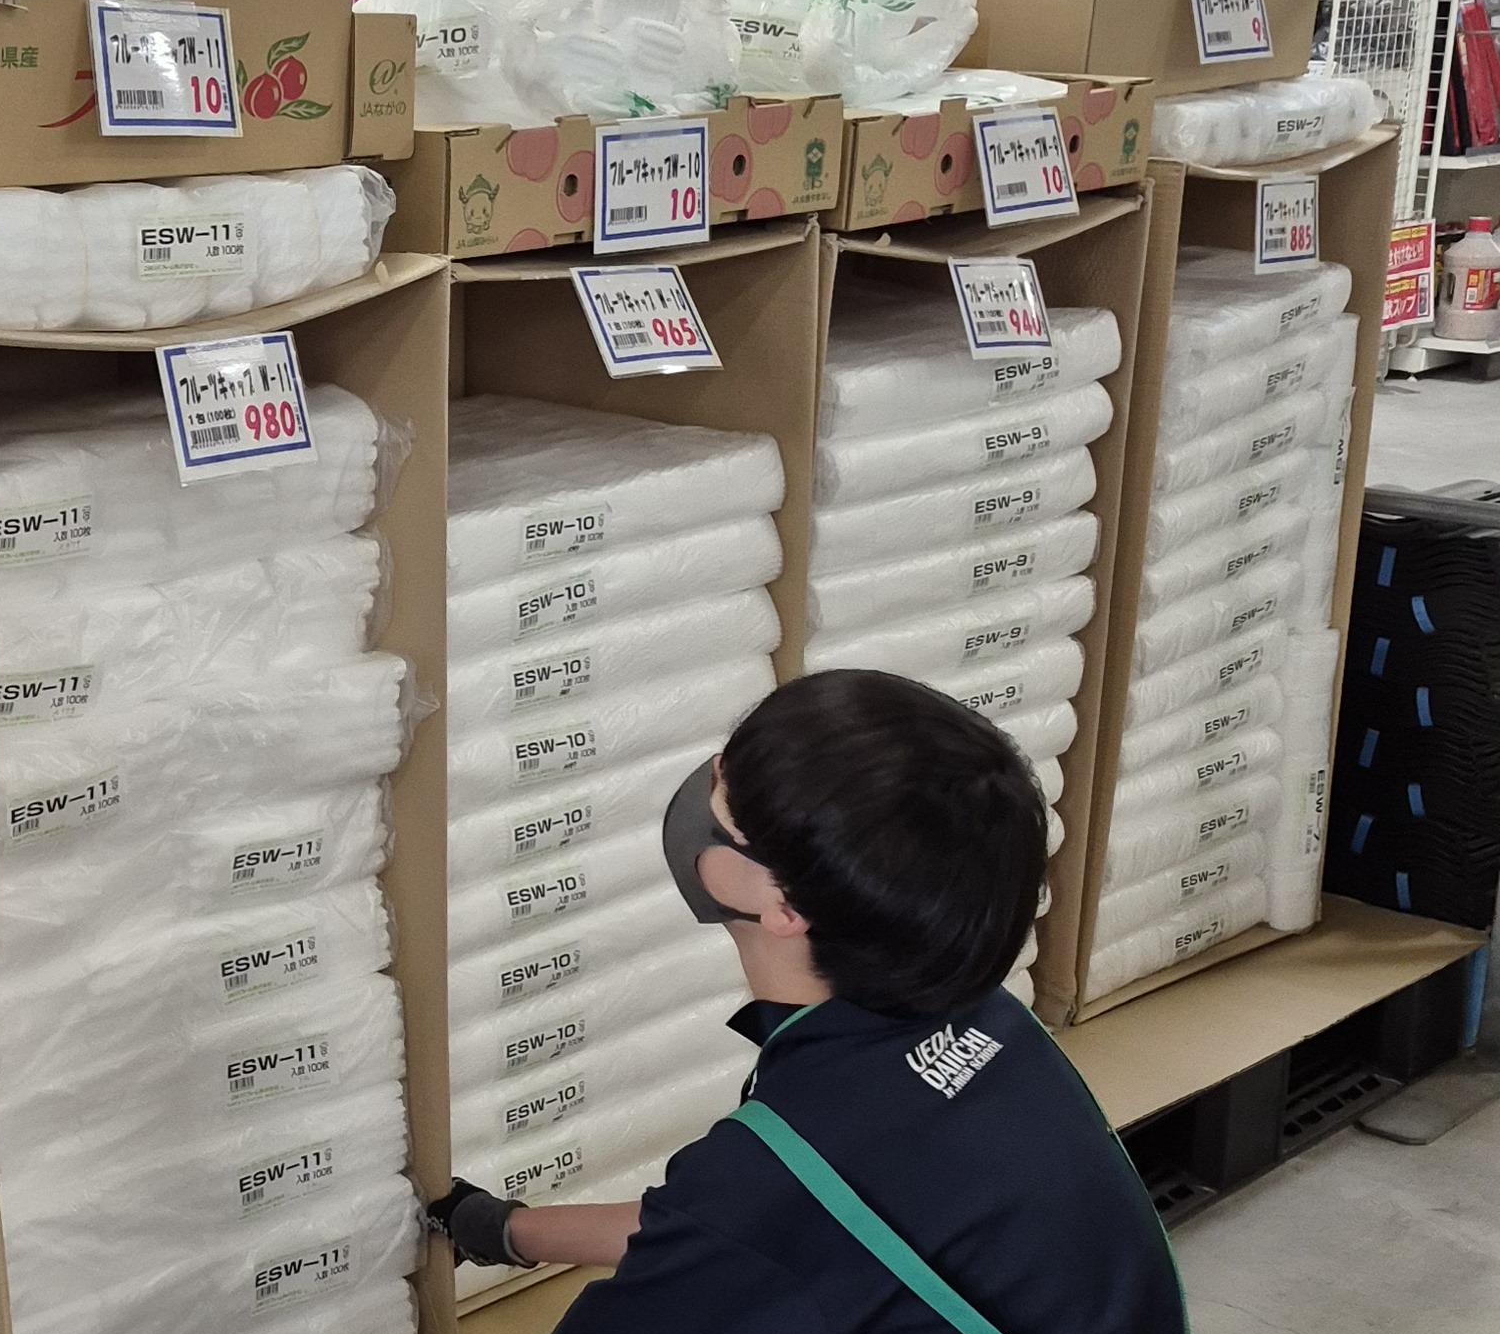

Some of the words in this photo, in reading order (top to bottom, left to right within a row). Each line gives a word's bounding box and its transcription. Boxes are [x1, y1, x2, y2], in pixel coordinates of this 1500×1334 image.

[728, 18, 800, 38] ESW-
[1251, 17, 1262, 43] 9
[190, 75, 222, 114] 10
[360, 100, 406, 117] JAながの
[1276, 117, 1321, 133] ESW-7
[1042, 164, 1064, 195] 10
[670, 186, 697, 221] 10
[141, 224, 230, 246] ESW-11
[1290, 224, 1312, 252] 885
[1009, 308, 1043, 337] 940
[1281, 297, 1319, 323] ESW-7
[652, 317, 698, 347] 965
[994, 356, 1053, 382] ESW-9
[1267, 363, 1303, 387] ESW-7
[179, 368, 256, 406] フルーツキャップ
[258, 362, 293, 393] W-11
[244, 400, 296, 441] 980
[986, 427, 1043, 451] ESW-9
[1252, 427, 1293, 452] ESW-7
[975, 490, 1034, 514] ESW-9
[1238, 486, 1278, 511] ESW-7
[525, 515, 595, 540] ESW-10
[974, 554, 1028, 578] ESW-9
[1227, 545, 1270, 573] ESW-7
[518, 582, 586, 618] ESW-10
[1232, 600, 1273, 628] ESW-7
[965, 627, 1022, 650] ESW-9
[513, 658, 582, 688] ESW-10
[1220, 649, 1260, 680] ESW-7
[1205, 709, 1247, 735] ESW-7
[515, 731, 586, 760] ESW-10
[1197, 752, 1242, 780] ESW-7
[10, 780, 109, 825] ESW-11
[514, 807, 583, 842] ESW-10
[1200, 808, 1246, 834] ESW-7
[232, 840, 315, 871] ESW-11
[507, 875, 577, 907] ESW-10
[1181, 865, 1226, 890] ESW-7
[1175, 921, 1220, 950] ESW-7
[220, 939, 306, 978] ESW-11
[501, 953, 571, 988] ESW-10
[506, 1023, 576, 1059] ESW-10
[905, 1023, 956, 1074] UEDA
[226, 1043, 317, 1080] ESW-11
[920, 1027, 994, 1091] DAIICHI
[942, 1067, 976, 1100] Jr.HIGH
[968, 1041, 1004, 1072] SCHOOL
[506, 1084, 577, 1124] ESW-10
[238, 1151, 322, 1194] ESW-11
[504, 1151, 574, 1191] ESW-10
[254, 1245, 341, 1289] ESW-11
